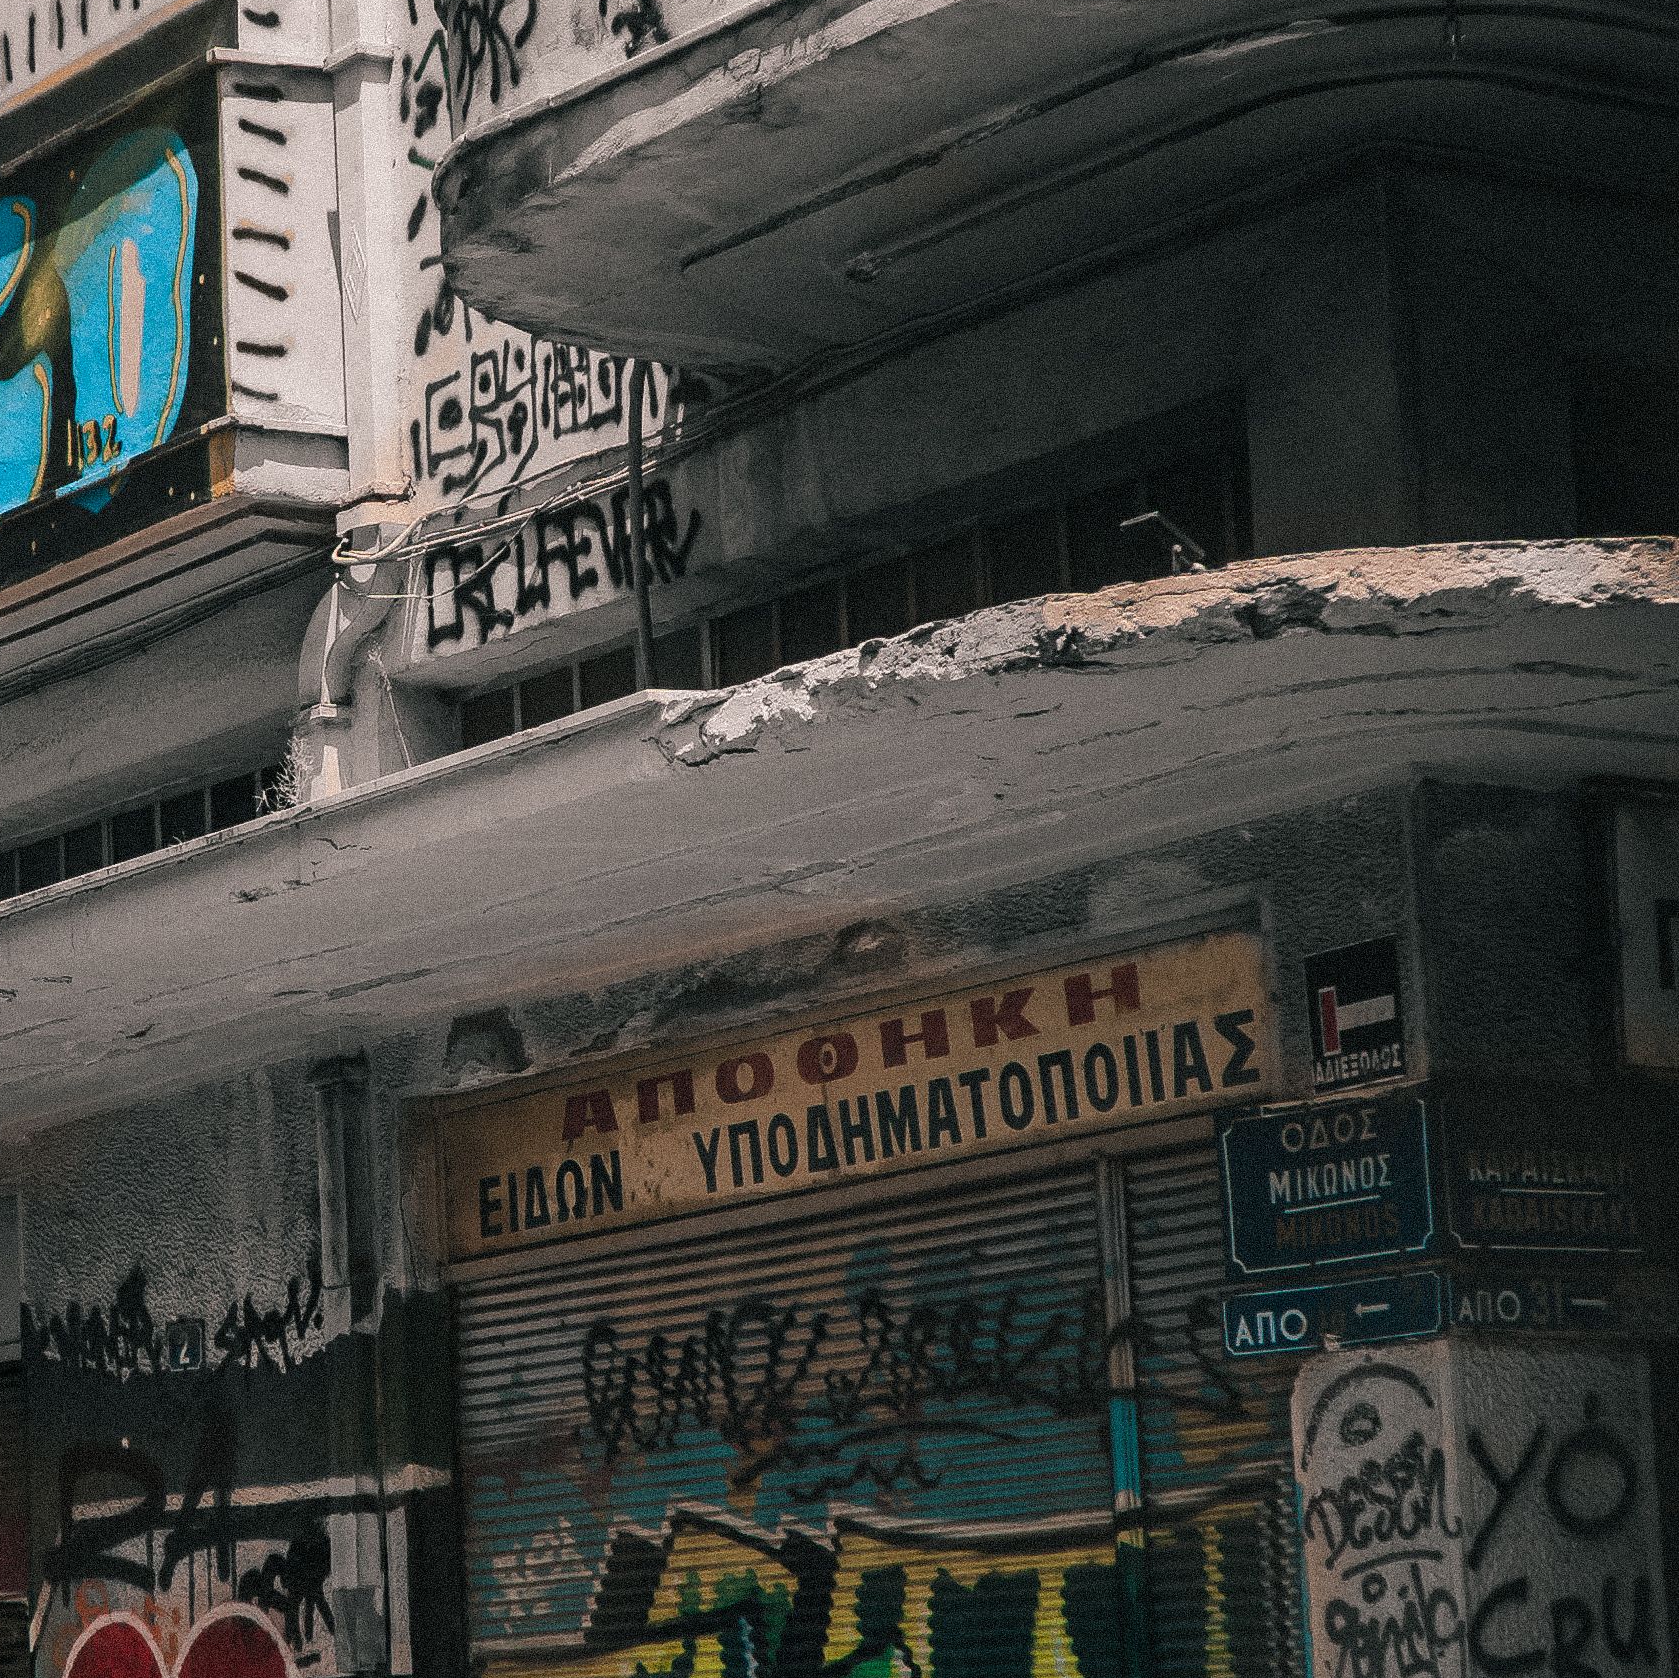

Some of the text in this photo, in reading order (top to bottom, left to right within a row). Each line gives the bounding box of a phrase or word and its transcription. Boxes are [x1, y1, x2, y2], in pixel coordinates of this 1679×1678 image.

[561, 962, 1142, 1143] ΑΠΟΘΗΚΗ
[1281, 1108, 1378, 1152] ΟΔΟΣ
[478, 1148, 625, 1239] ΕΙΔΩΝ
[1269, 1154, 1392, 1204] ΜΙΚΩΝΟΣ
[1275, 1204, 1401, 1251] MIKONOS
[1235, 1308, 1308, 1348] ΑΠΟ
[1459, 1289, 1522, 1323] ΑΠΟ
